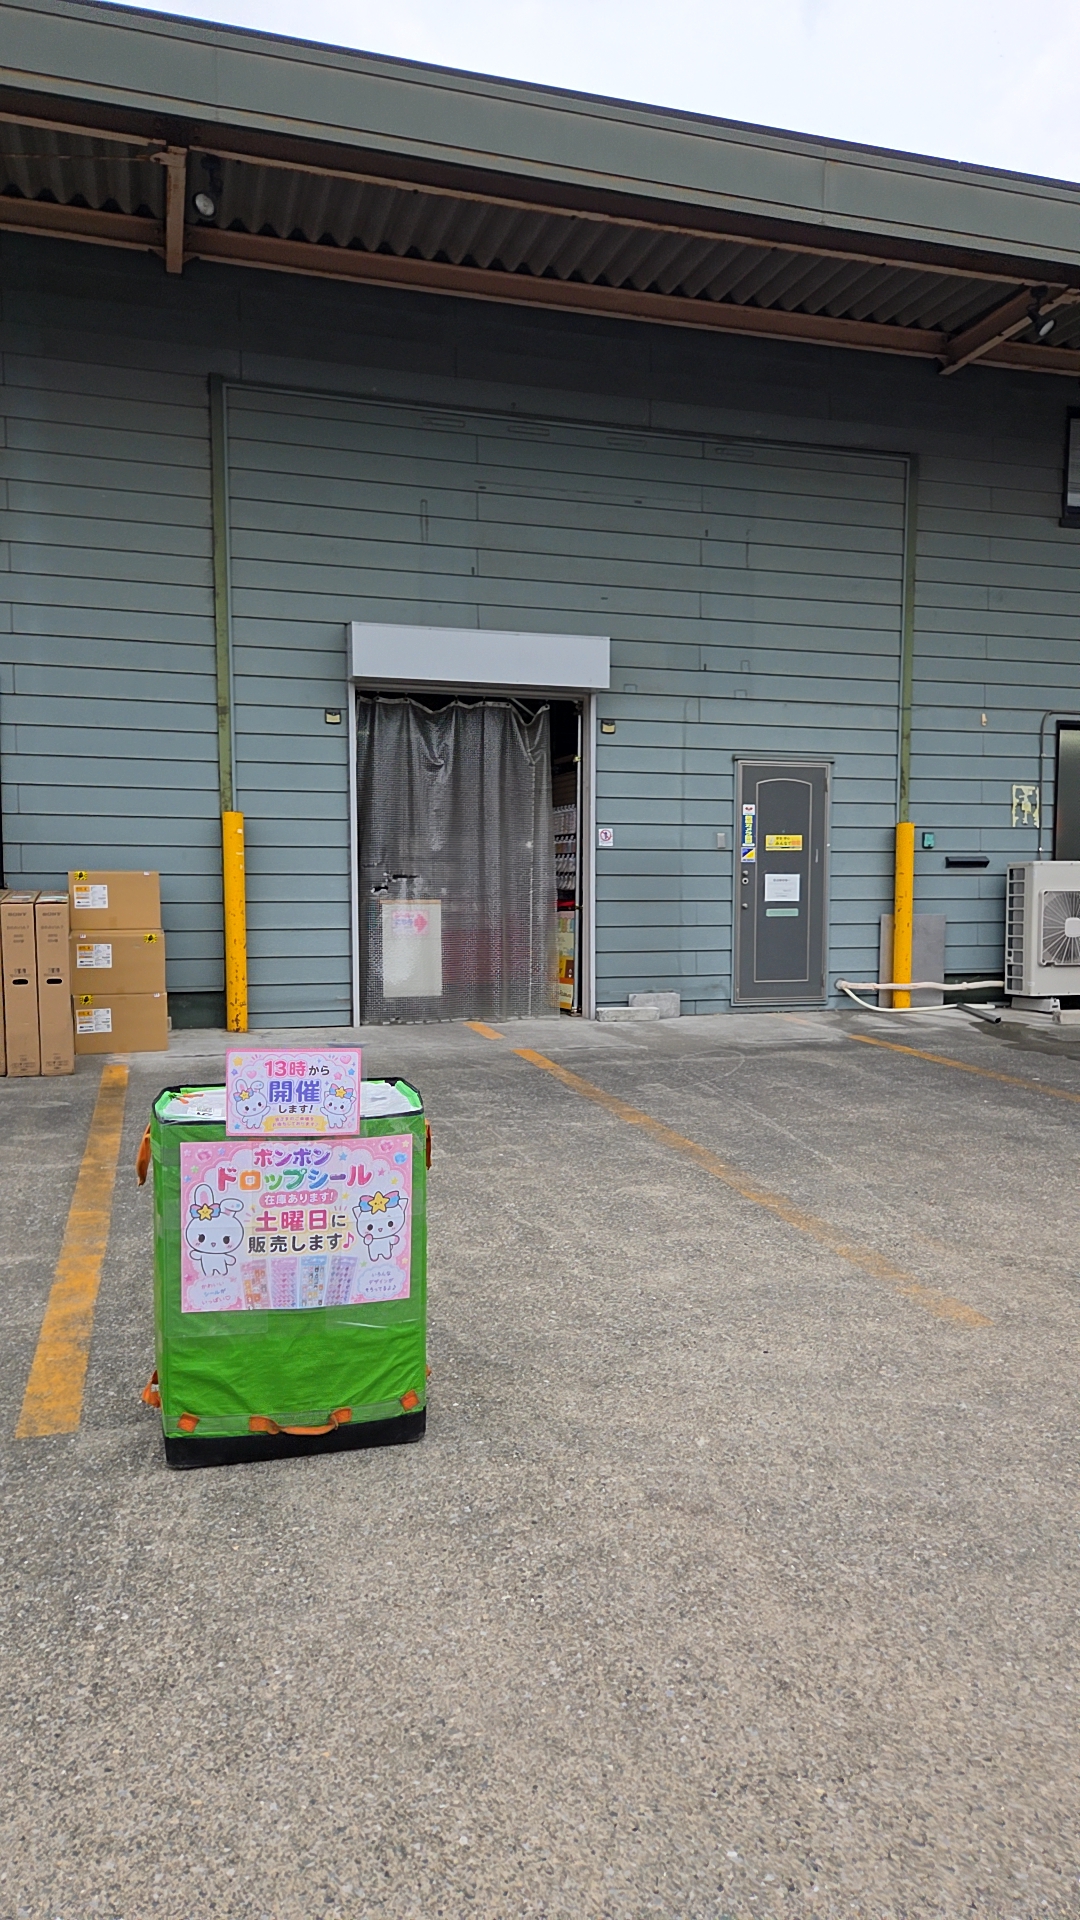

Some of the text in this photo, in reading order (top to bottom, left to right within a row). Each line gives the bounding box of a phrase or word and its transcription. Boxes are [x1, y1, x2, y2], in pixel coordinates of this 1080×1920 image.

[264, 1060, 330, 1077] 13時から
[268, 1080, 320, 1103] 開催
[278, 1104, 314, 1114] します!
[254, 1147, 331, 1167] ボンボン
[217, 1164, 372, 1192] ドロップシール
[264, 1191, 334, 1206] 在庫あります!
[254, 1209, 346, 1232] 土曜日に
[201, 1281, 225, 1289] かわいい
[203, 1288, 227, 1297] シールが
